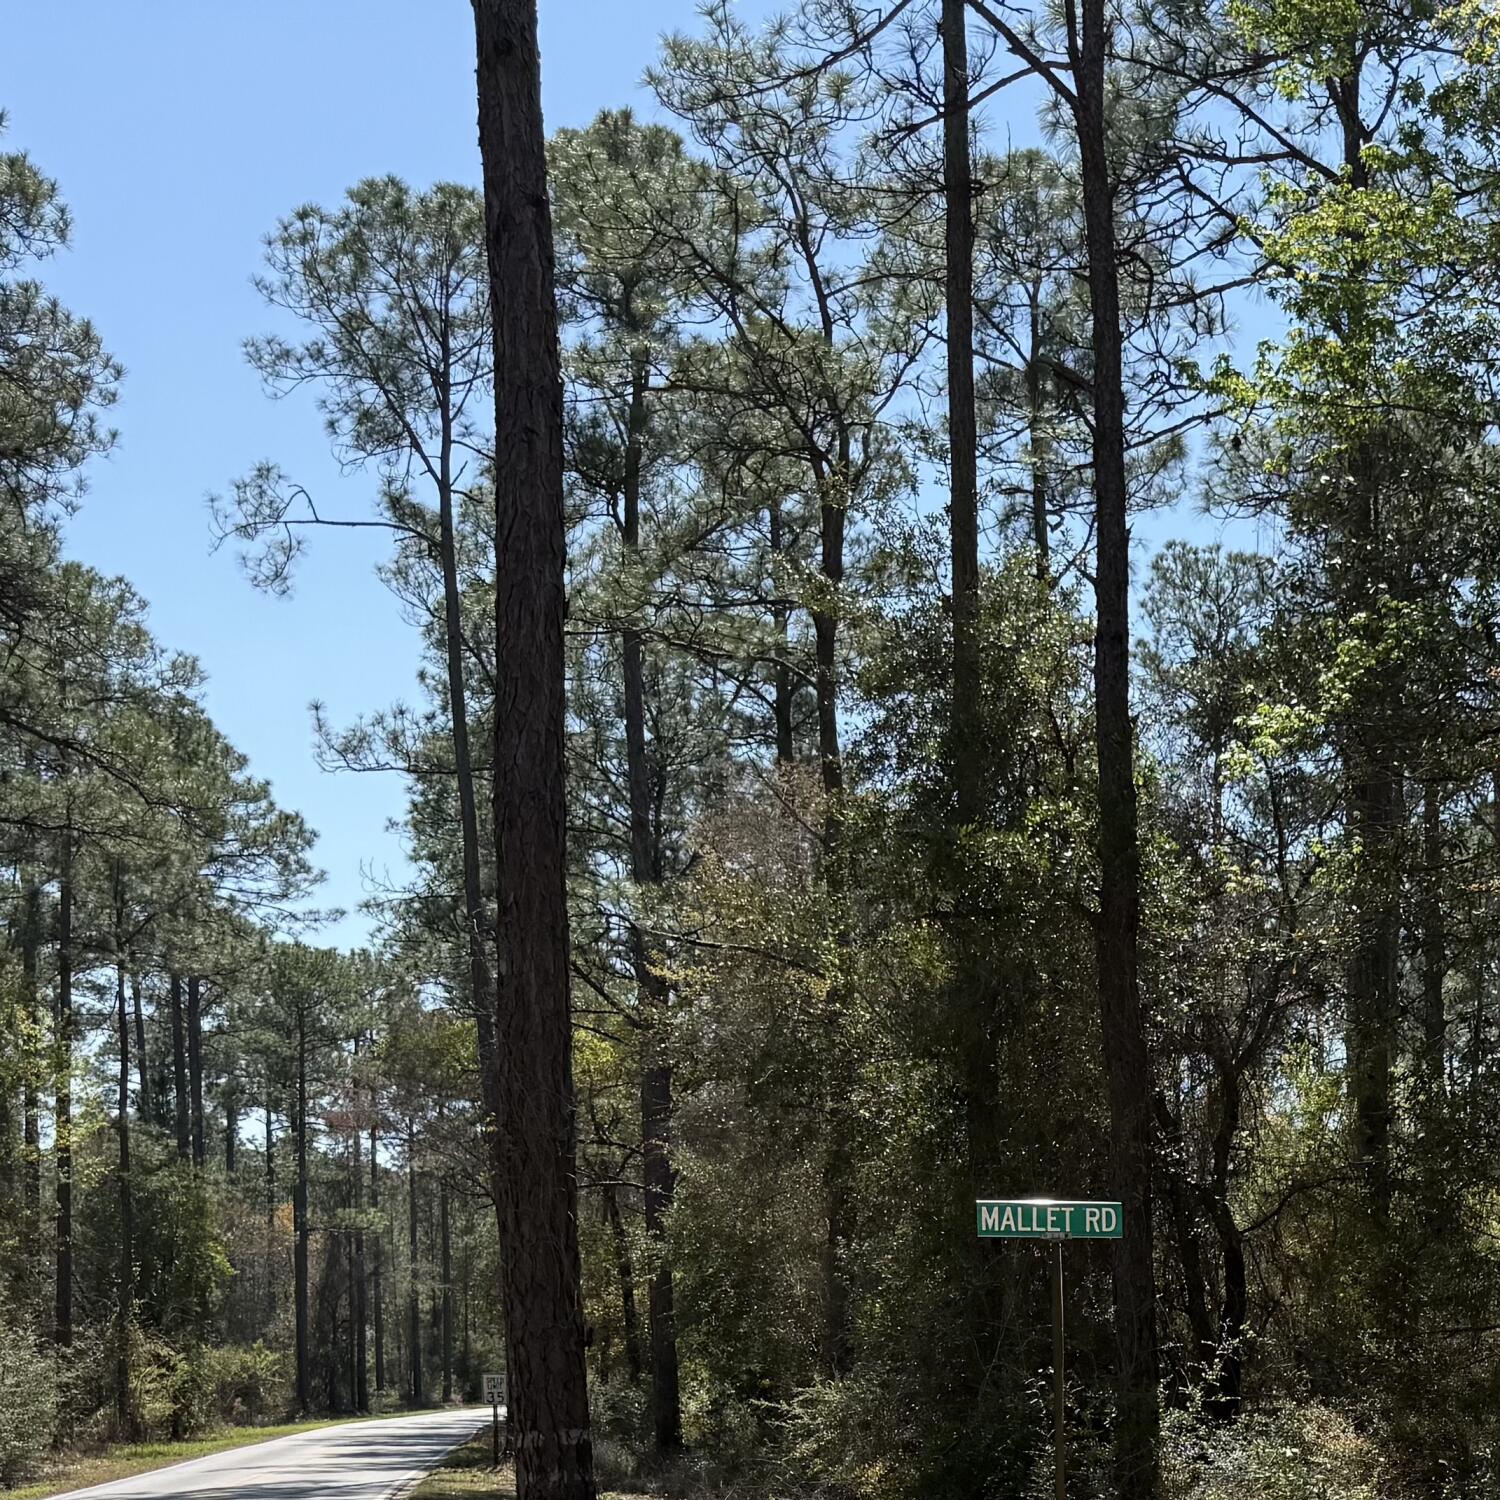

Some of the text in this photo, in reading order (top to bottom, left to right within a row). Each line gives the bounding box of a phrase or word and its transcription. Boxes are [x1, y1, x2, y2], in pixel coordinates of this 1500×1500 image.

[981, 1206, 1116, 1232] MALLET RD
[486, 1391, 505, 1403] 35
